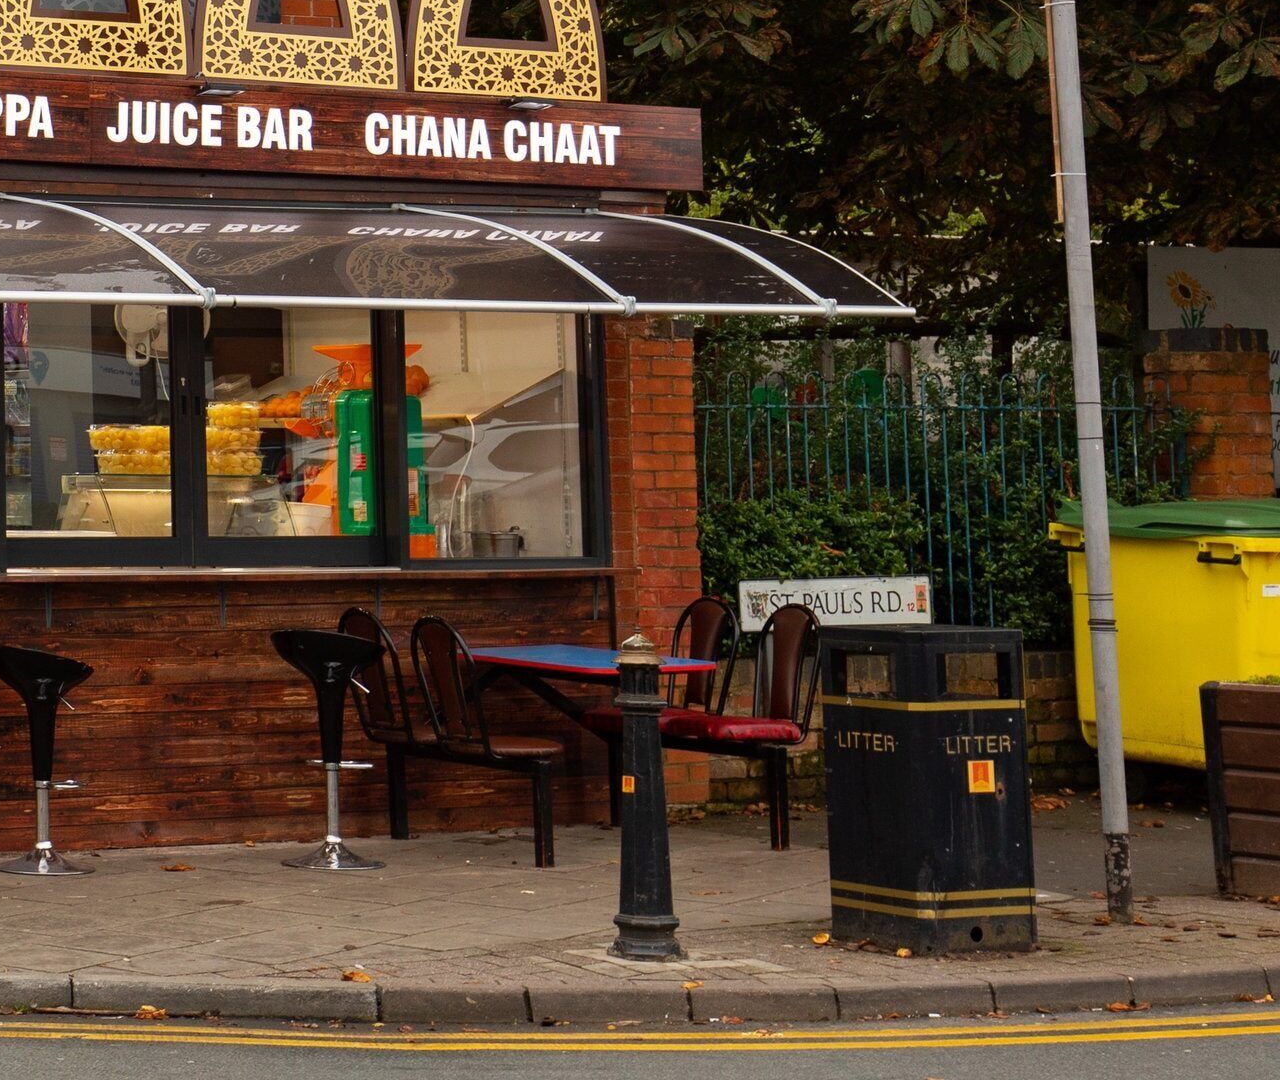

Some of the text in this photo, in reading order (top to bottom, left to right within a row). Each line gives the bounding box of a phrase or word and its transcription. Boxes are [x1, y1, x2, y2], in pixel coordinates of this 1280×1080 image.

[107, 100, 223, 147] JUICE
[236, 104, 314, 151] BAR
[364, 112, 493, 160] CHANA
[503, 118, 621, 166] CHAAT
[803, 591, 863, 614] PAULS
[838, 731, 895, 753] LITTER
[946, 735, 1012, 754] LITTER
